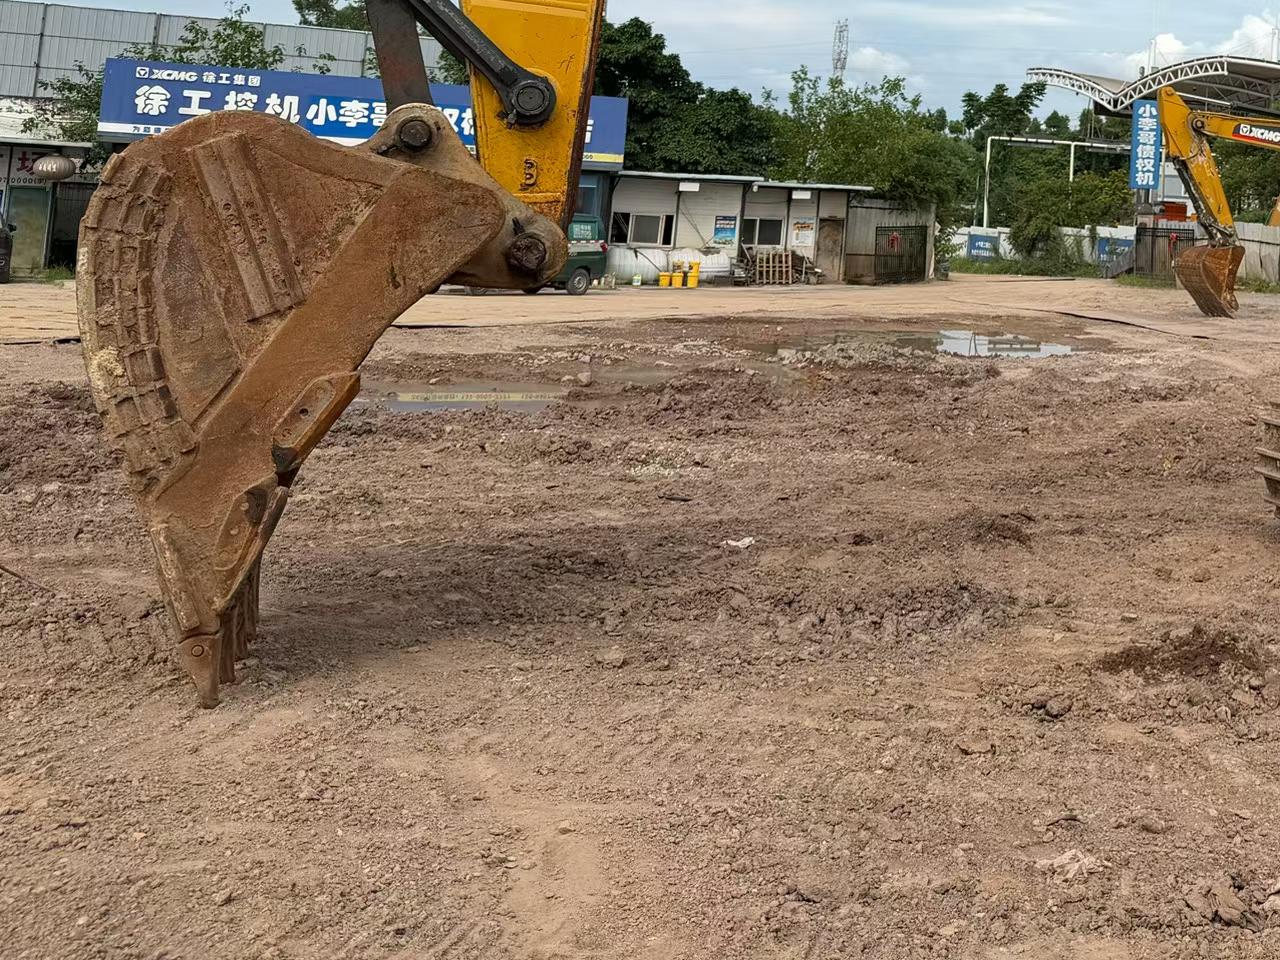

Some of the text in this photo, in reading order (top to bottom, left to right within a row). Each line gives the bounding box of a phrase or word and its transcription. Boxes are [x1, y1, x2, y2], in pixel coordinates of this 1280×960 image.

[150, 69, 261, 87] XCMG 徐工集团
[1135, 103, 1158, 186] 小李哥债权机
